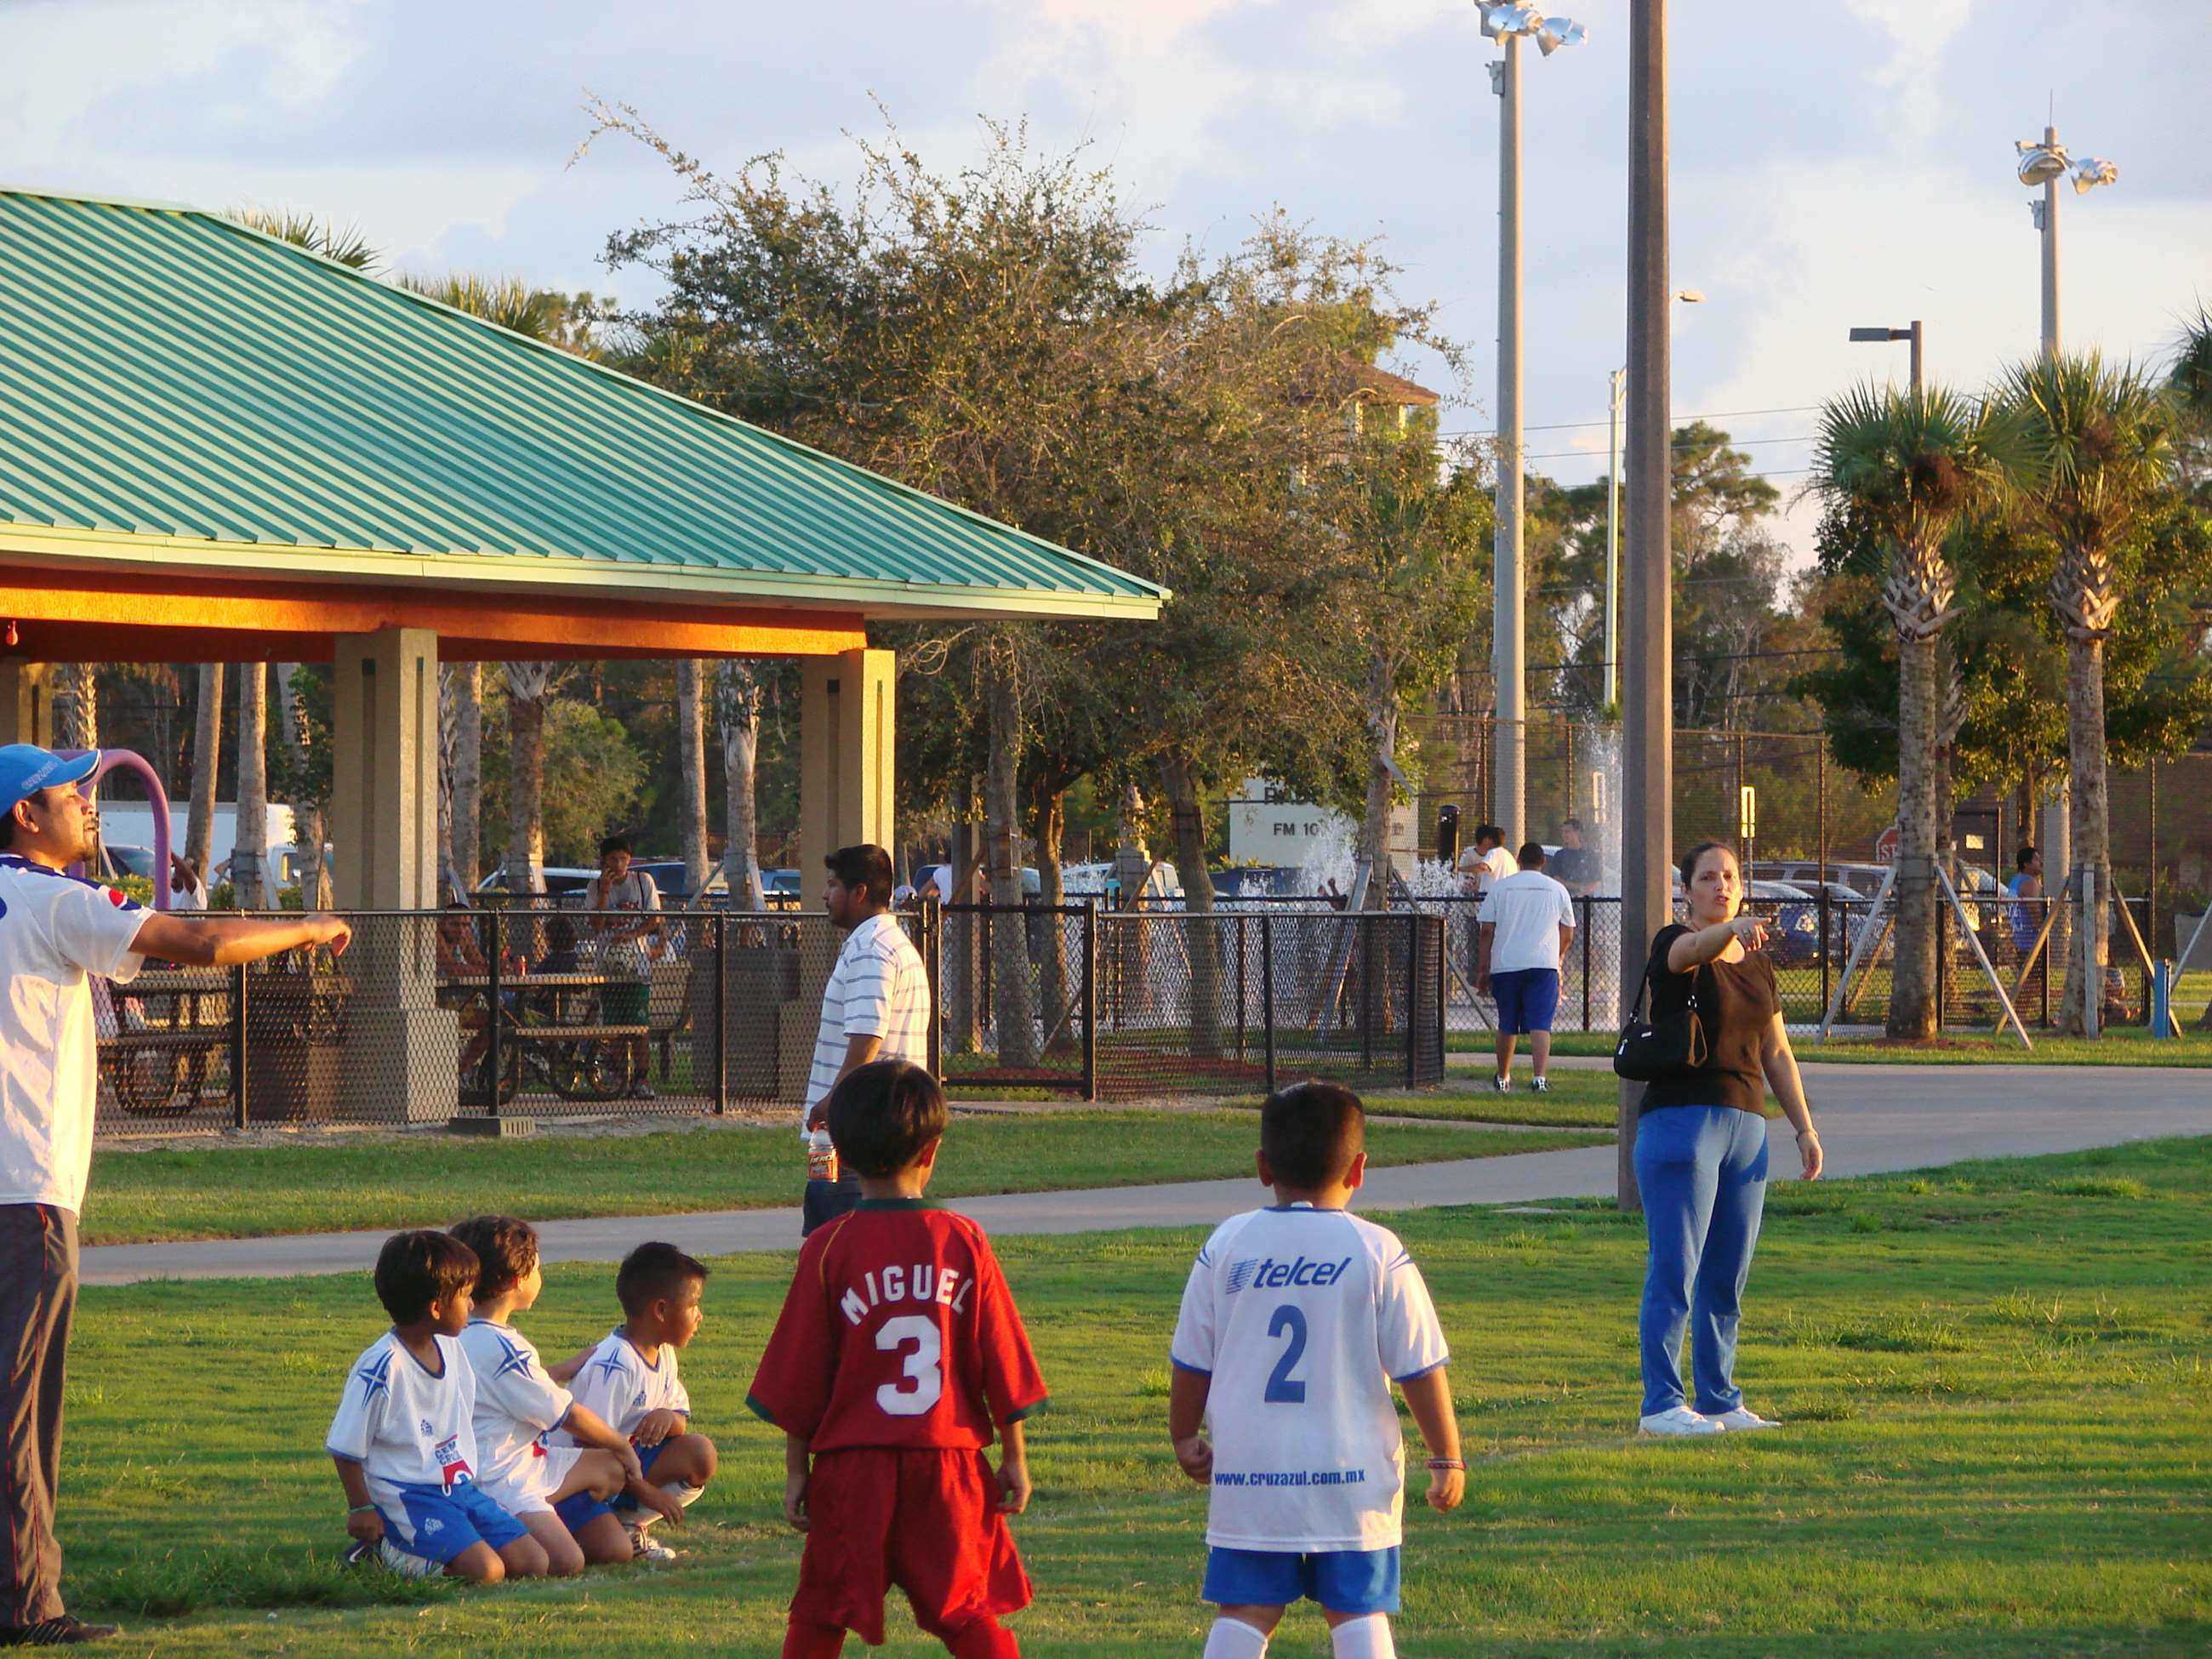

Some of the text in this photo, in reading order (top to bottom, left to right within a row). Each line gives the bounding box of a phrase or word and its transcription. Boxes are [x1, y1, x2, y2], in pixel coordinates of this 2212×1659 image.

[1273, 823, 1295, 836] FM
[840, 1264, 973, 1326] MIGUEL
[1253, 1256, 1353, 1289] telcel
[875, 1314, 941, 1416] 3
[1264, 1304, 1307, 1404] 2
[1214, 1468, 1365, 1486] www.cruzazul.com.mx
